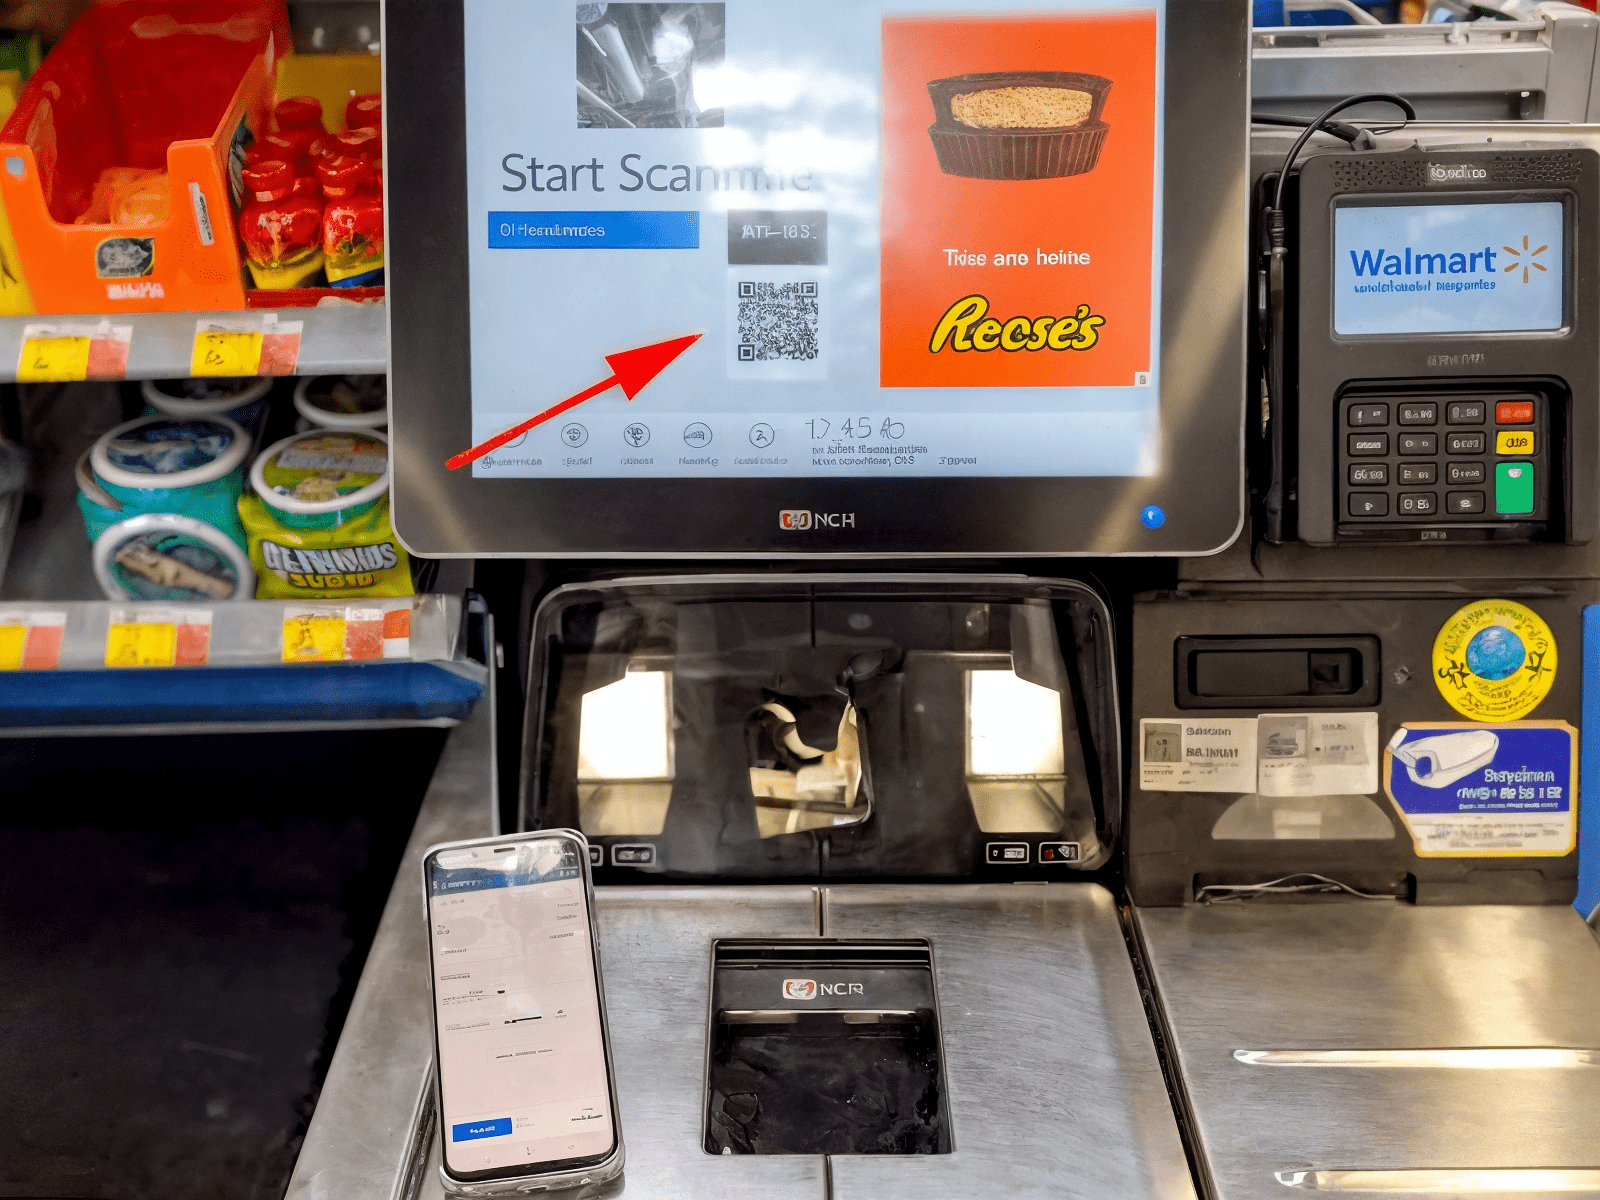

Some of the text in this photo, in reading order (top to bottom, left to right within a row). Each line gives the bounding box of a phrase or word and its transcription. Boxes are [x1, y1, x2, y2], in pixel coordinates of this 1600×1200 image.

[501, 152, 605, 193] Start
[1349, 246, 1497, 277] Walmart
[819, 982, 864, 996] NCR
